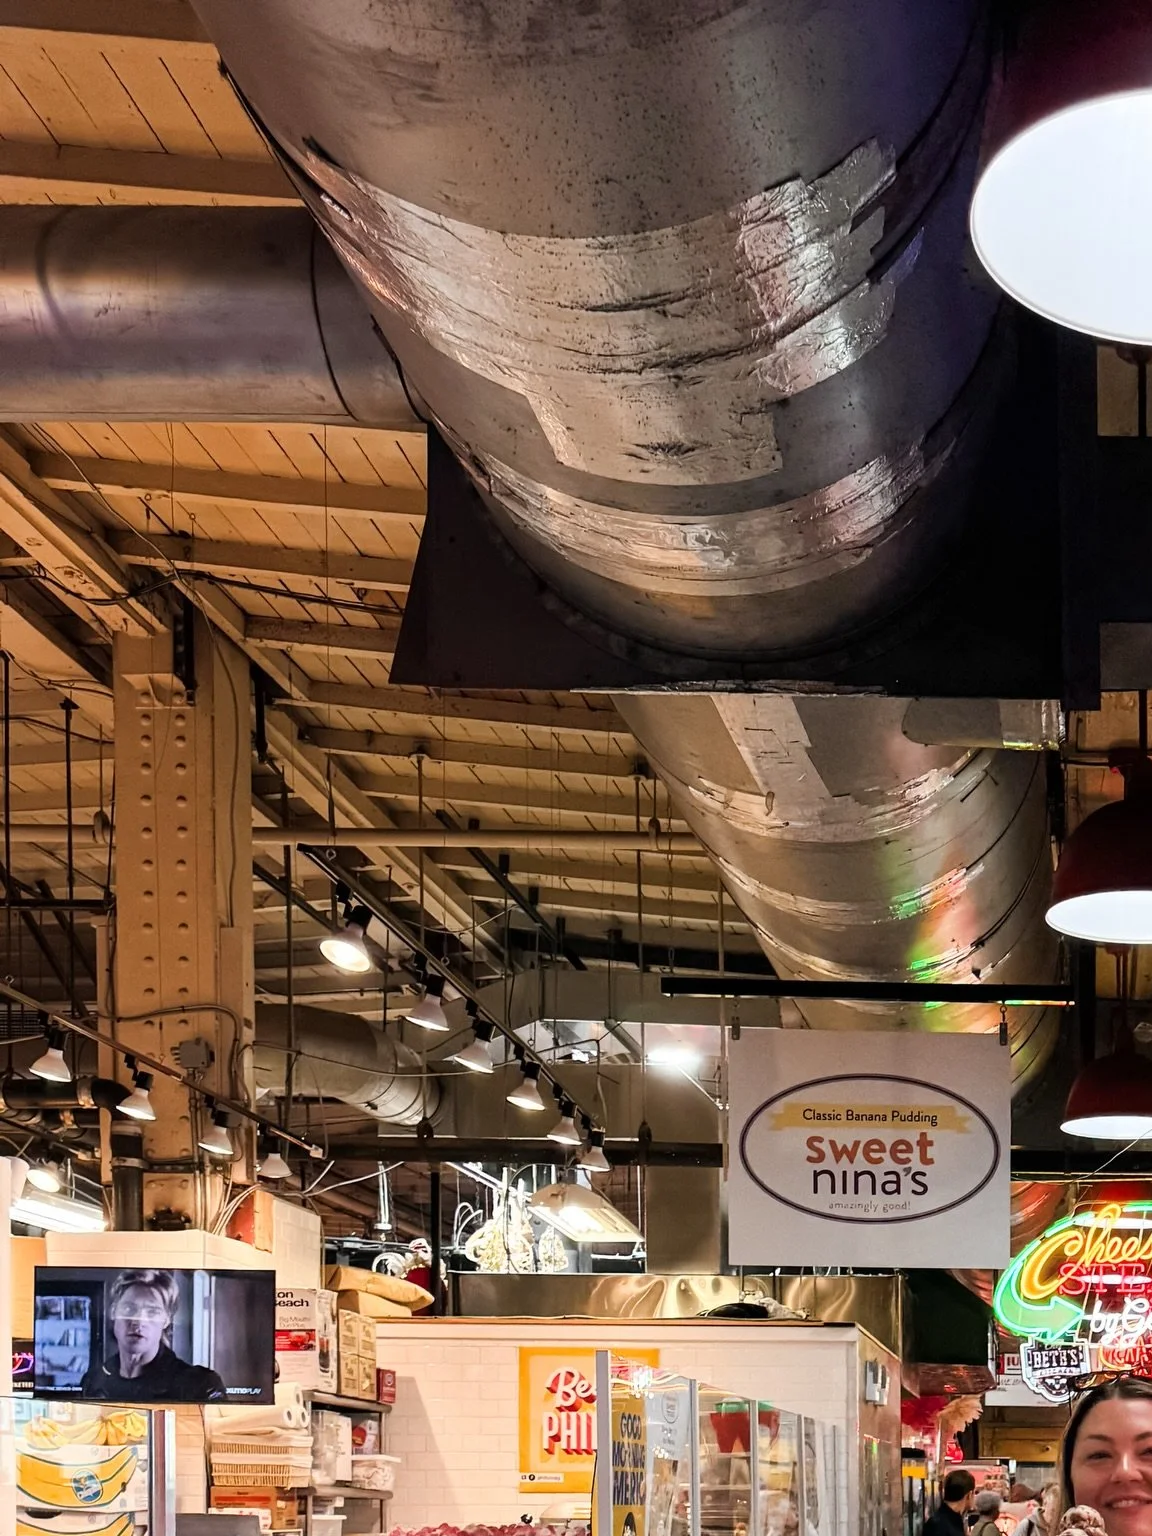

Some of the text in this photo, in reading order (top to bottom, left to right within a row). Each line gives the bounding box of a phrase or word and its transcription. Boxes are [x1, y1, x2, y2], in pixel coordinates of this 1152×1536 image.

[802, 1108, 938, 1127] Classic Banana Pudding
[806, 1132, 935, 1166] sweet
[812, 1166, 929, 1196] nina's
[828, 1201, 911, 1213] amazingly good!
[1032, 1348, 1080, 1369] BETH'S
[545, 1367, 597, 1410] Be
